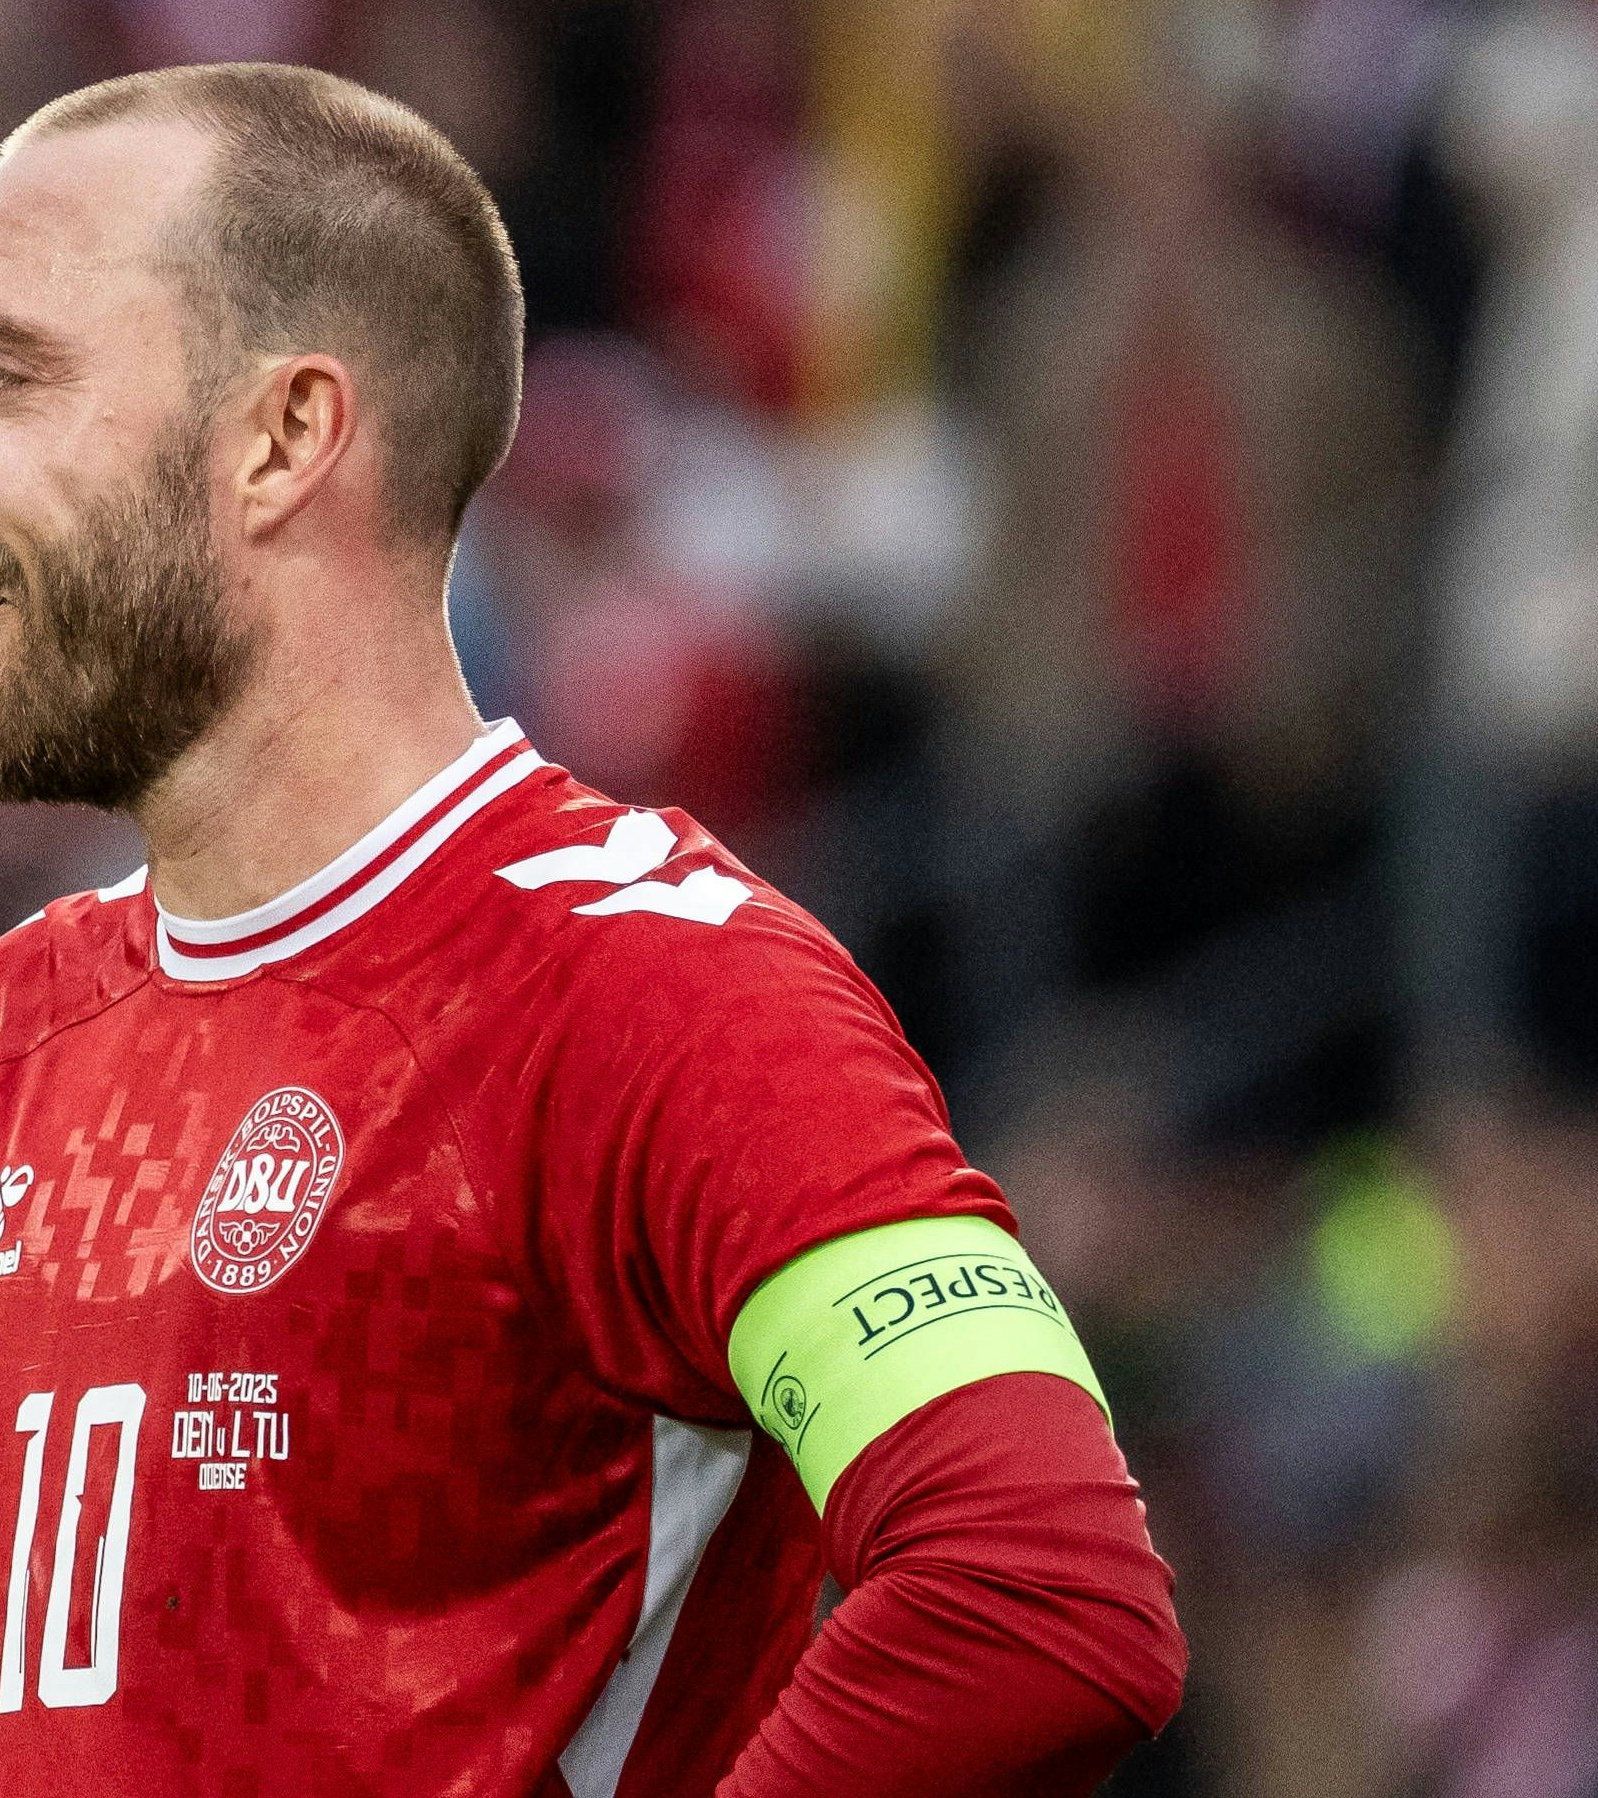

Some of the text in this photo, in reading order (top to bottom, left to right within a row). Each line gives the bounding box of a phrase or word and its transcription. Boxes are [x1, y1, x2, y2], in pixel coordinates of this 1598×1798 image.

[217, 1153, 310, 1214] DBU
[210, 1259, 272, 1287] 1889
[852, 1264, 1059, 1346] RESPECT
[187, 1372, 279, 1404] 10-06-2025
[171, 1410, 214, 1459] DEN
[231, 1410, 289, 1460] LTU
